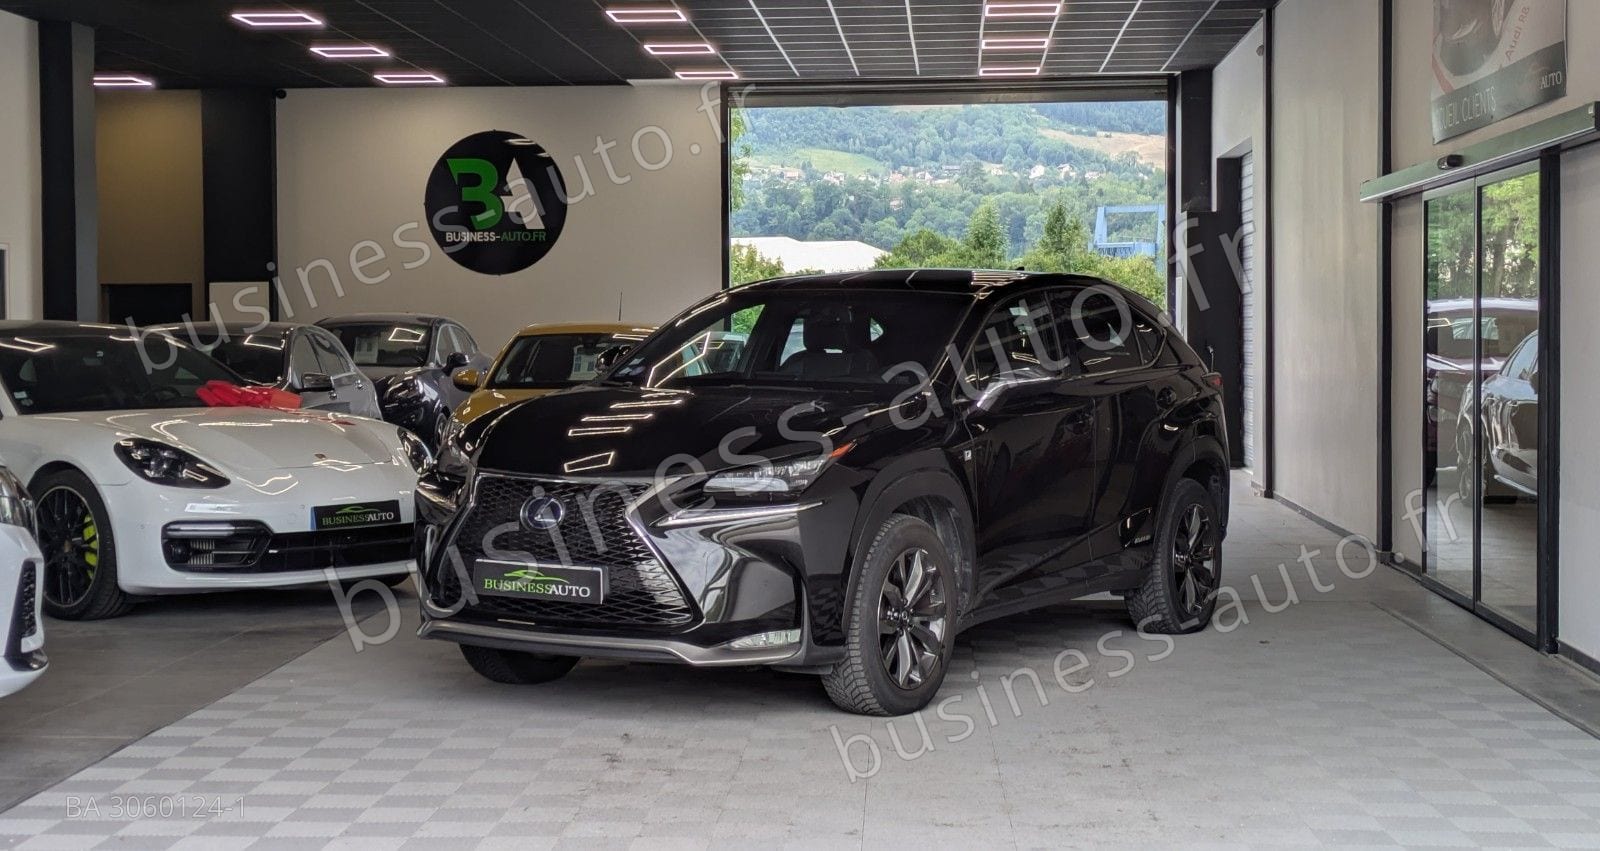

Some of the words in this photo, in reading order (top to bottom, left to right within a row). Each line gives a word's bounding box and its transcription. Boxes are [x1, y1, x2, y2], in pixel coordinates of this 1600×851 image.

[1505, 26, 1522, 61] Audi
[1461, 86, 1497, 121] CLIENTS
[446, 231, 547, 242] BUSINESS-AUTO.FR
